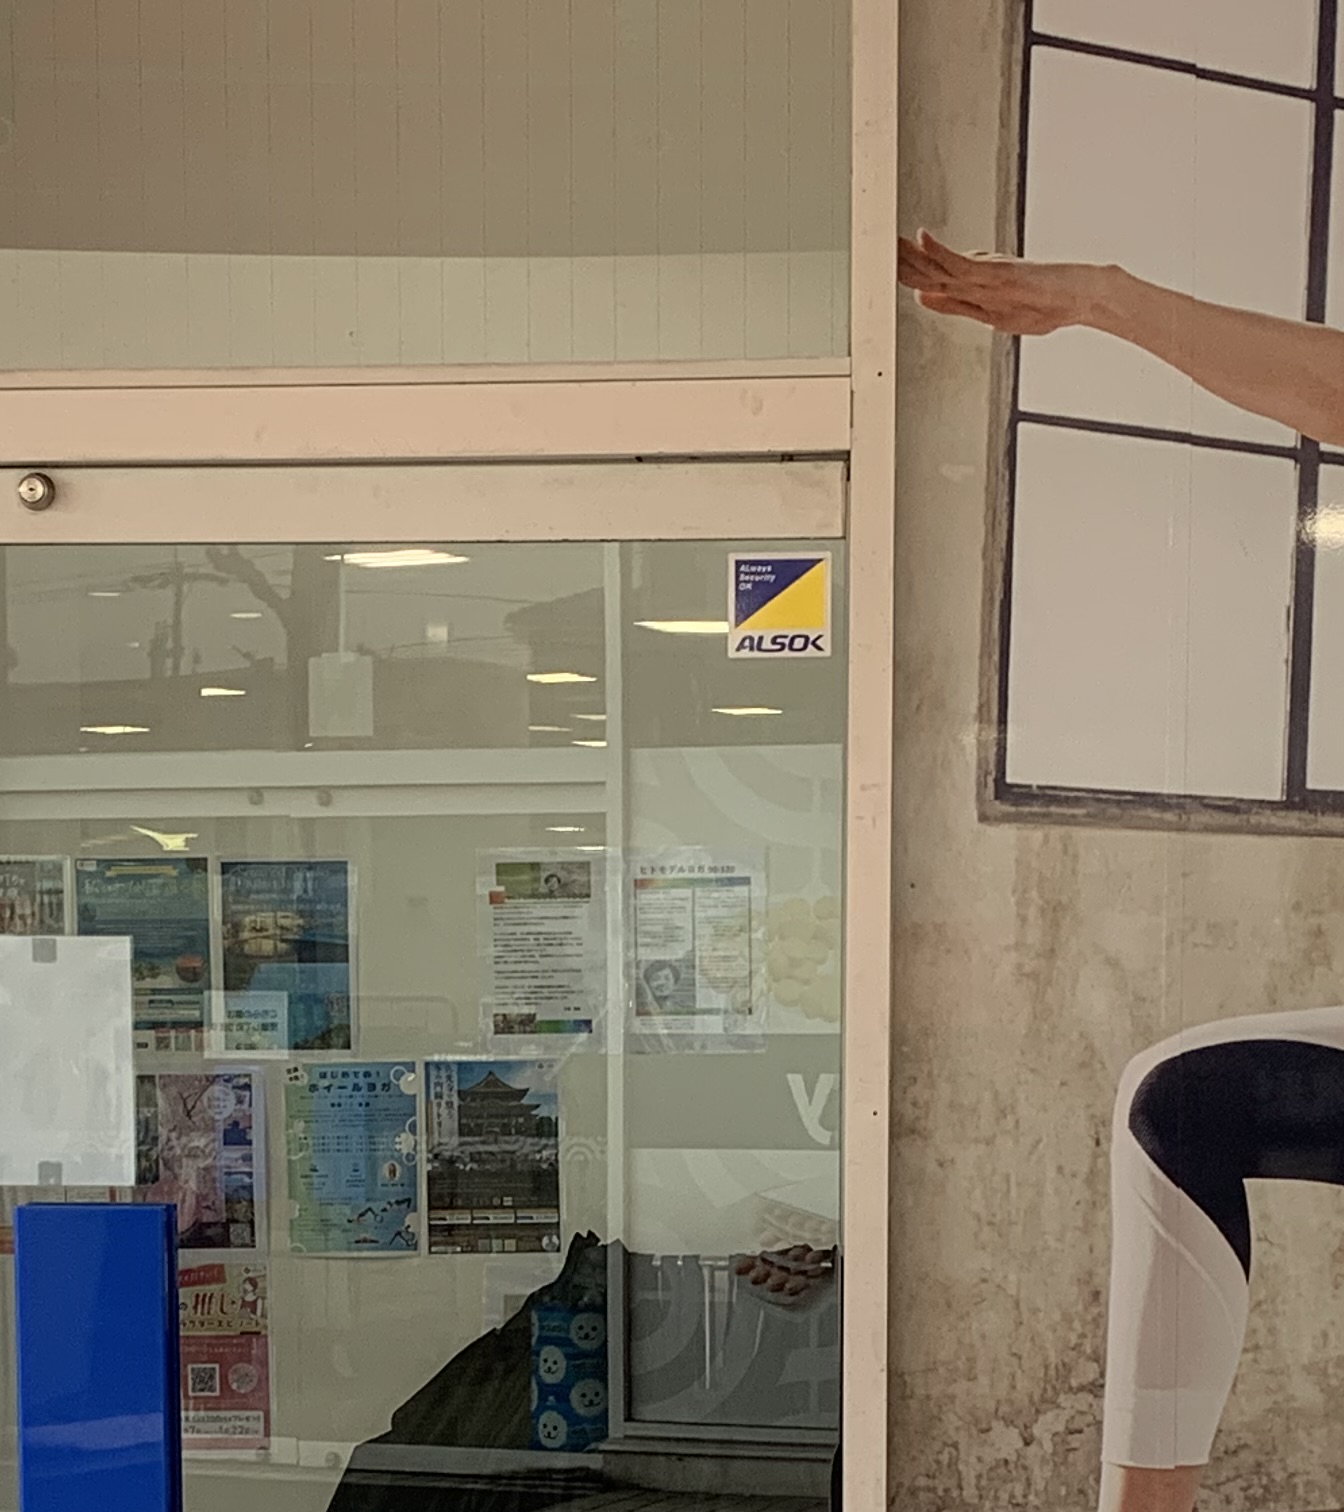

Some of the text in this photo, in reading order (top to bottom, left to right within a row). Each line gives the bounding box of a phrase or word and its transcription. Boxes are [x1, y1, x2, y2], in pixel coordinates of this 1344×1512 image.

[739, 573, 776, 583] Security
[738, 582, 753, 591] OK
[735, 634, 825, 653] ALSOK
[307, 1082, 392, 1094] ホイールヨガ
